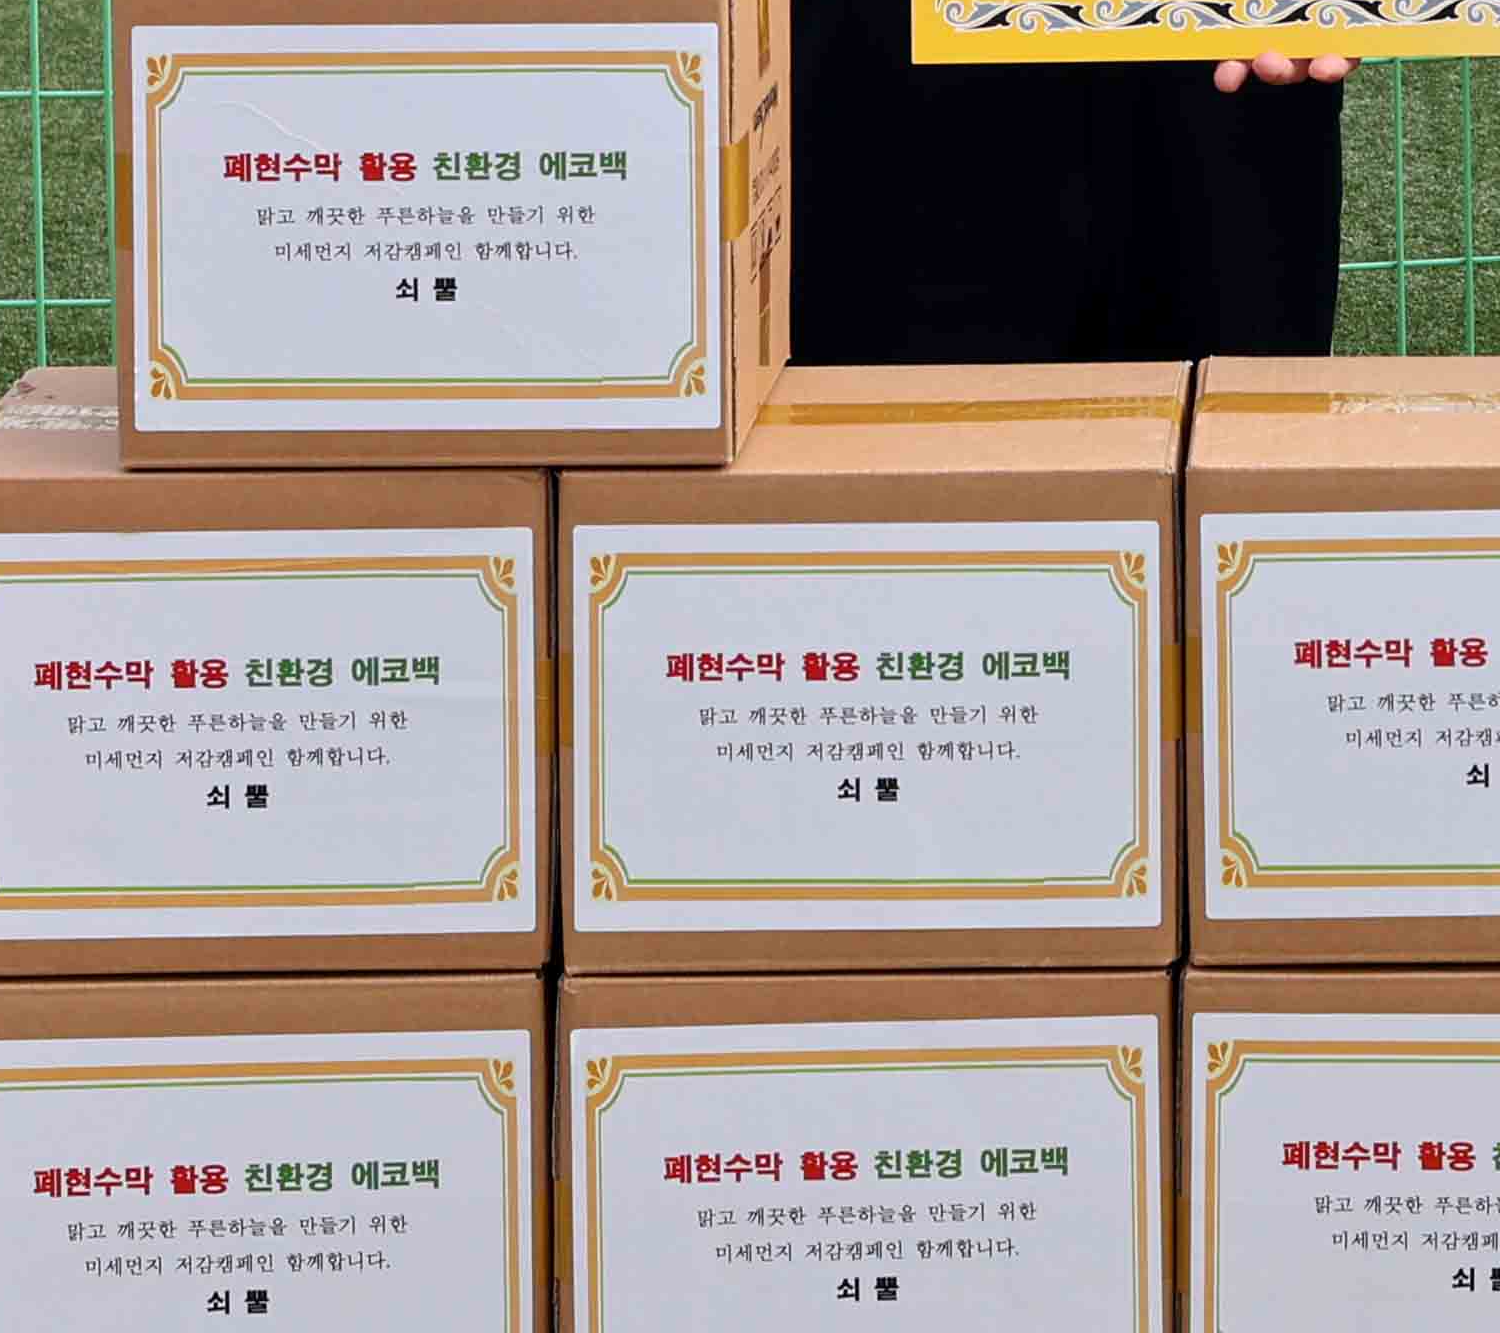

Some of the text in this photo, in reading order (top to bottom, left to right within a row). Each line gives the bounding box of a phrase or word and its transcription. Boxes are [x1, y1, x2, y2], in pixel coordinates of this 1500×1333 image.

[223, 150, 627, 183] 폐현수막 활용 친환경 에코백
[256, 204, 596, 226] 맑고 깨끗한 푸른하늘을 만들기 위한
[275, 240, 577, 262] 미세먼지 저감캠페인 함께합니다.
[665, 650, 1070, 683] 폐현수막 활용 친환경 에코백
[1293, 638, 1414, 670] 폐현수막
[1429, 637, 1489, 668] 활용
[33, 655, 440, 691] 폐현수막 활용 친환경 에코백
[1327, 693, 1367, 714] 맑고
[1377, 692, 1437, 712] 깨끗한
[1345, 728, 1422, 750] 미세먼지
[663, 1146, 1069, 1185] 폐현수막 활용 친환경 에코백
[1281, 1140, 1402, 1172] 폐현수막
[1417, 1140, 1477, 1172] 활용
[33, 1158, 440, 1198] 폐현수막 활용 친환경 에코백
[67, 1214, 408, 1242] 맑고 깨끗한 푸른하늘을 만들기 위한
[85, 1250, 391, 1278] 미세먼지 저감캠페인 함께합니다.
